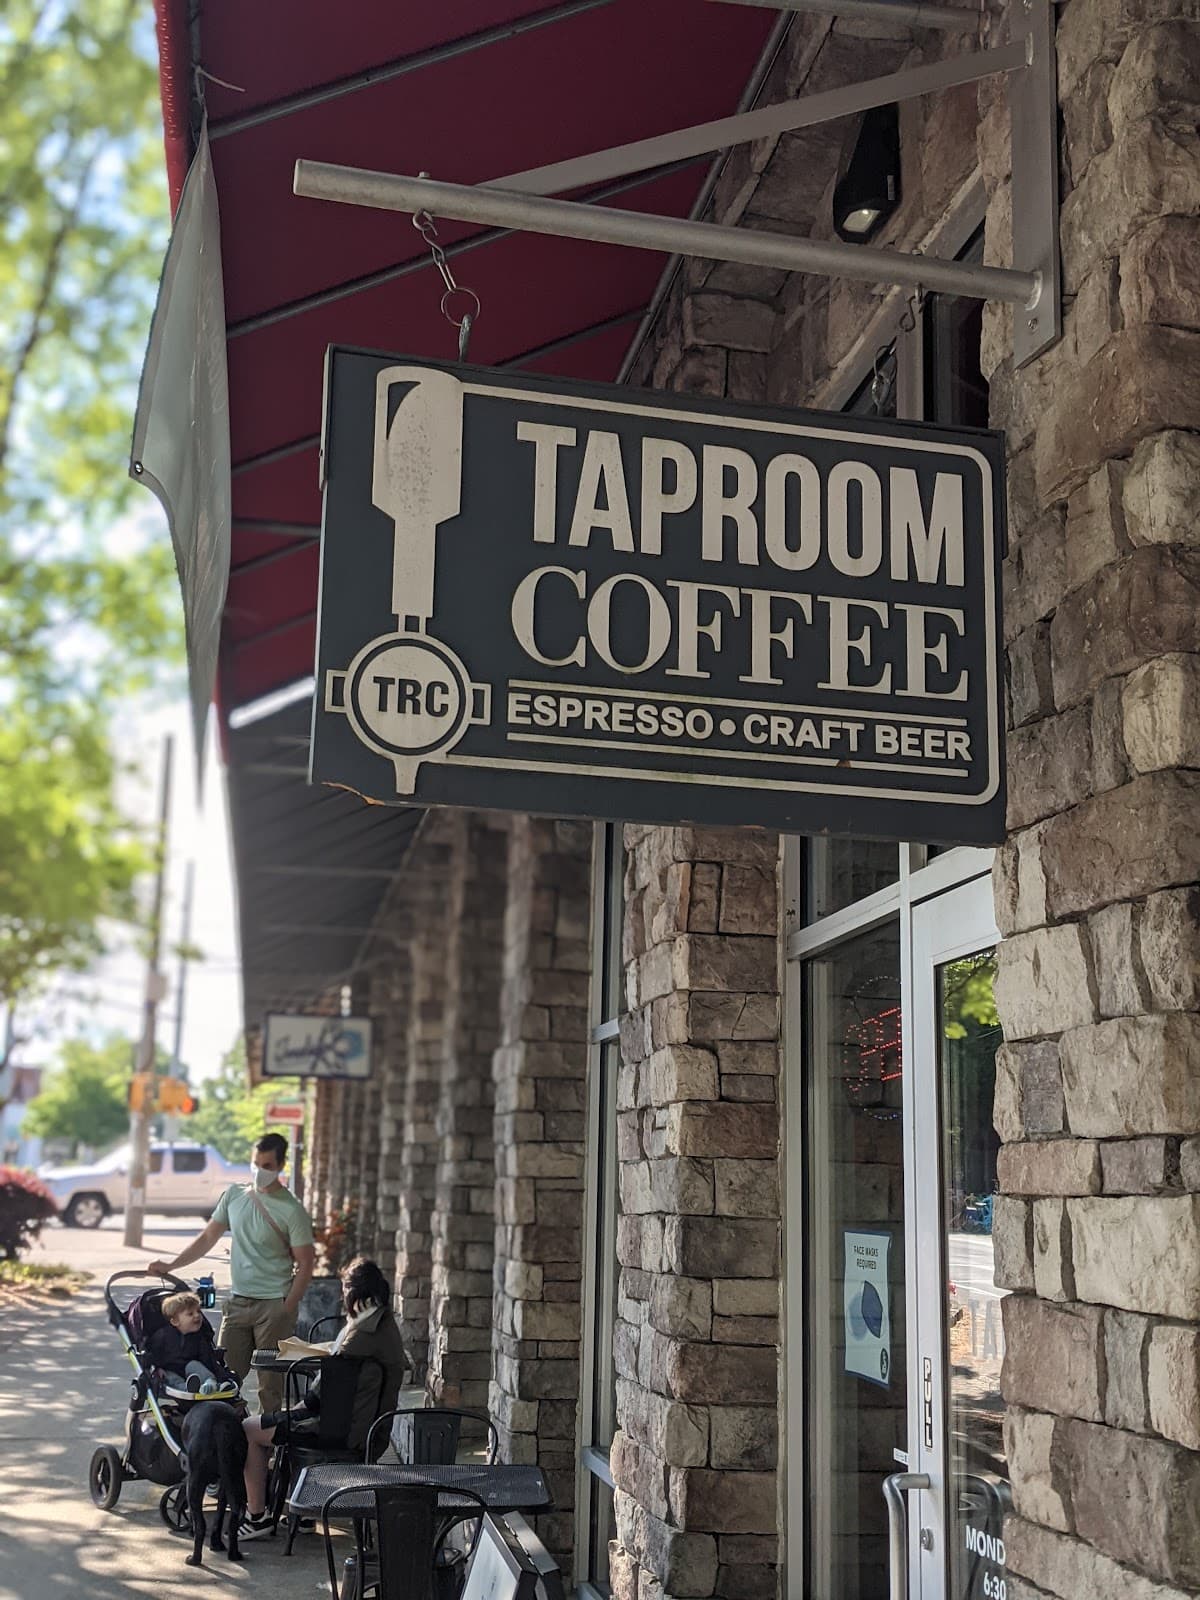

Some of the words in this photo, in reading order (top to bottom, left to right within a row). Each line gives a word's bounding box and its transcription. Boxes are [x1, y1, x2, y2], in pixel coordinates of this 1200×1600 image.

[516, 420, 966, 588] TAPROOM
[510, 565, 969, 703] COFFEE
[373, 676, 449, 718] TRC
[507, 692, 714, 740] ESPRESSO
[743, 713, 865, 752] CRAFT
[875, 724, 973, 762] BEER
[843, 1007, 903, 1092] OPE
[853, 1244, 865, 1256] FACE
[856, 1257, 877, 1270] REQUIRED
[923, 1357, 933, 1447] PULL
[983, 1571, 1007, 1600] 6:30
